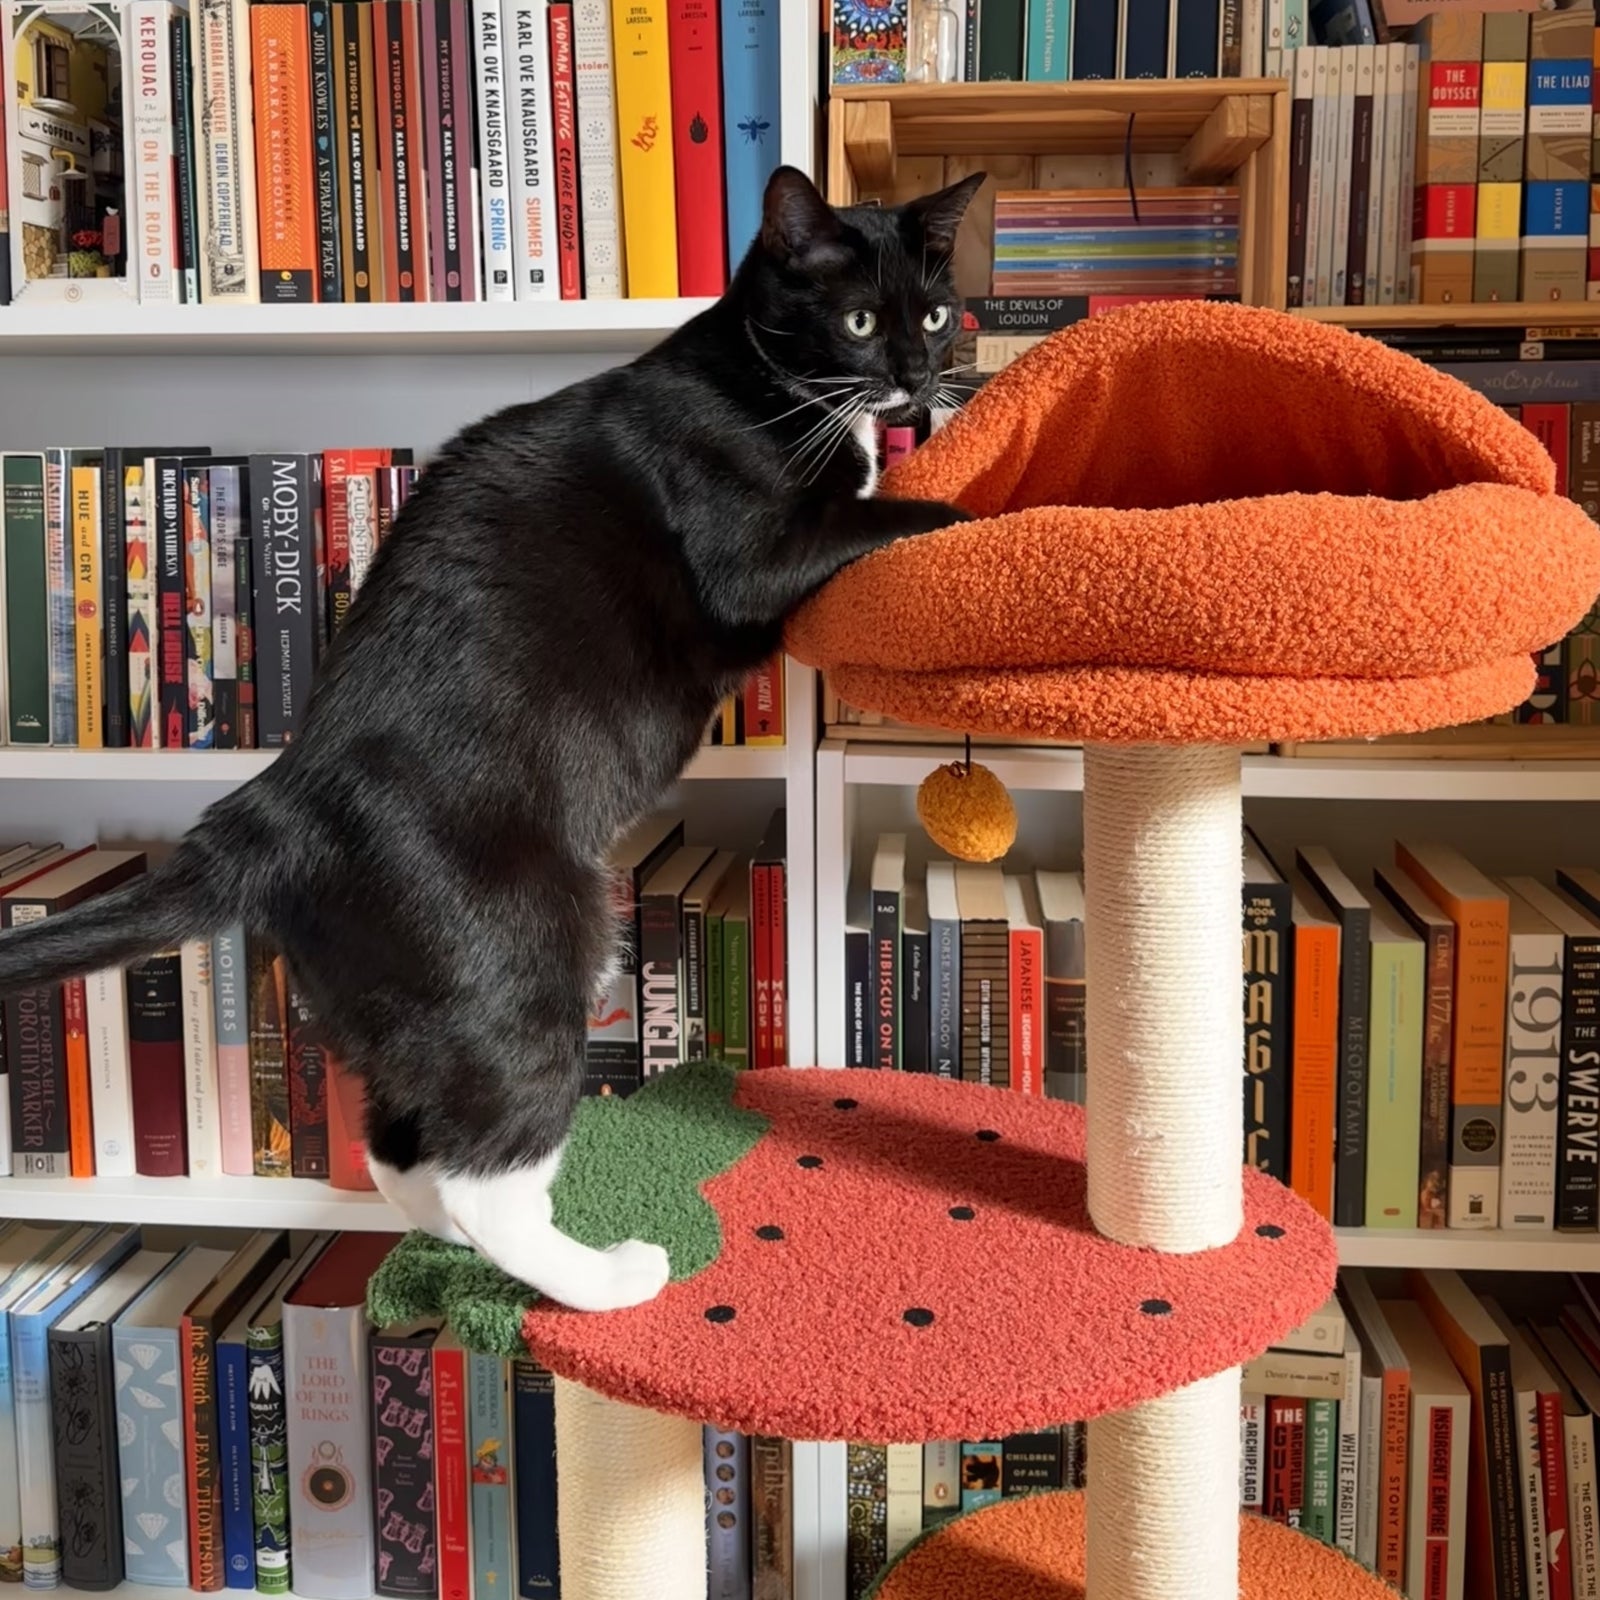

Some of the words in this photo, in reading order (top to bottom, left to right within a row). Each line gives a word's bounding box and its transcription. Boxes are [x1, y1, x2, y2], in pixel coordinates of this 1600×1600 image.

[482, 12, 496, 50] KARL
[517, 10, 531, 49] KARL
[626, 17, 652, 25] LARSSON
[139, 16, 157, 97] KEROUAC
[209, 21, 222, 67] BARBARA
[313, 31, 326, 73] JOHN
[348, 42, 356, 57] MY
[392, 40, 400, 56] MY
[552, 16, 569, 77] WOMAN,
[1043, 36, 1052, 73] Poems
[267, 38, 281, 121] BARBARA
[392, 58, 402, 111] STRUGGLE
[441, 58, 451, 111] STRUGGLE
[484, 56, 498, 83] OVE
[519, 55, 534, 82] OVE
[577, 61, 609, 71] stolen
[1446, 69, 1467, 83] THE
[1537, 75, 1557, 88] THE
[1561, 73, 1590, 88] ILIAD
[211, 70, 228, 133] KINGSOLVER
[315, 72, 328, 130] KNOWLES
[349, 60, 359, 111] STRUGGLE
[1432, 86, 1478, 101] ODYSSEY
[555, 80, 571, 140] EATING
[42, 119, 74, 142] COFFEE
[281, 85, 292, 176] POISONWOOD
[352, 132, 362, 159] KARL
[396, 132, 406, 159] KARL
[444, 131, 454, 159] KARL
[485, 90, 503, 188] KNAUSGAARD
[521, 88, 540, 187] KNAUSGAARD
[143, 140, 160, 163] ON
[215, 142, 228, 179] DEMON
[318, 157, 329, 165] A
[445, 160, 454, 180] OVE
[144, 172, 160, 202] THE
[271, 129, 286, 241] KINGSOLVER
[353, 161, 362, 180] OVE
[397, 161, 406, 180] OVE
[559, 147, 573, 198] CLAIRE
[216, 181, 233, 247] COPPERHEAD
[319, 170, 333, 234] SEPARATE
[354, 184, 365, 251] KNAUSGAARD
[398, 184, 409, 251] KNAUSGAARD
[446, 183, 457, 251] KNAUSGAARD
[1446, 189, 1456, 233] HOMER
[145, 211, 161, 257] ROAD
[490, 198, 507, 251] SPRING
[526, 197, 543, 258] SUMMER
[321, 240, 335, 279] PEACE
[984, 300, 1004, 311] THE
[1009, 299, 1045, 312] DEVILS
[1047, 299, 1063, 310] OF
[998, 314, 1049, 325] LOUDUN
[329, 457, 344, 485] SAM
[78, 490, 89, 521] HUE
[162, 468, 177, 519] RICHARD
[215, 486, 226, 503] THE
[332, 489, 345, 499] J.
[80, 526, 89, 547] and
[216, 506, 227, 545] RAZOR'S
[263, 519, 271, 539] THE
[272, 459, 302, 615] MOBY-DICK
[333, 502, 348, 551] MILLER
[164, 520, 179, 577] MATHESON
[264, 542, 272, 577] WHALE
[80, 553, 92, 584] CRY
[163, 592, 181, 627] HELL
[164, 631, 183, 685] HOUSE
[280, 629, 291, 670] HERMAN
[877, 905, 896, 914] RAO
[1246, 907, 1276, 917] BOOK
[1252, 898, 1271, 907] THE
[1254, 917, 1269, 926] OF
[941, 927, 952, 968] NORSE
[1436, 934, 1449, 970] CLINE
[218, 936, 237, 1032] MOTHERS
[854, 982, 862, 995] THE
[880, 939, 893, 1016] HIBISCUS
[981, 979, 991, 1002] EDITH
[1020, 940, 1033, 1010] JAPANESE
[642, 961, 680, 1077] JUNGLE
[756, 979, 768, 1027] MAUS
[771, 979, 784, 1027] MAUS
[940, 972, 951, 1049] MYTHOLOGY
[1430, 985, 1452, 1024] 1177
[191, 1018, 203, 1043] great
[774, 1034, 783, 1049] II
[855, 1019, 863, 1030] OF
[880, 1026, 893, 1050] ON
[981, 1004, 991, 1042] HAMILTON
[1021, 1012, 1032, 1057] LEGENDS
[1508, 951, 1564, 1113] 1913
[1574, 1026, 1597, 1038] THE
[760, 1035, 766, 1049] I
[41, 1015, 56, 1107] PORTABLE
[1344, 1015, 1363, 1157] MESOPOTAMIA
[22, 1079, 43, 1147] PARKER
[1566, 1048, 1600, 1164] SWERVE
[191, 1325, 207, 1348] the
[301, 1373, 346, 1387] LORD
[304, 1356, 338, 1370] THE
[295, 1391, 314, 1403] OF
[300, 1408, 350, 1422] RINGS
[1315, 1401, 1329, 1422] I'M
[1386, 1393, 1396, 1434] GATES,
[1397, 1384, 1406, 1424] HENRY
[1275, 1408, 1303, 1424] THE
[195, 1432, 210, 1479] JEAN
[1006, 1452, 1056, 1462] CHILDREN
[1244, 1421, 1259, 1502] ARCHIPELAGO
[1313, 1428, 1329, 1465] STILL
[1341, 1433, 1357, 1474] WHITE
[1432, 1408, 1450, 1480] INSURGENT
[1013, 1469, 1026, 1477] OF
[1027, 1469, 1049, 1477] ASH
[1290, 1424, 1304, 1505] ARCHIPELAGO
[1313, 1470, 1328, 1507] HERE
[1388, 1476, 1400, 1527] STONY
[1528, 1474, 1537, 1493] THE
[1581, 1481, 1591, 1502] THE
[1340, 1479, 1355, 1541] FRAGILITY
[1430, 1486, 1449, 1534] EMPIRE
[1530, 1496, 1540, 1533] RIGHTS
[197, 1486, 215, 1587] THOMPSON
[1387, 1534, 1399, 1561] THE
[1532, 1536, 1541, 1549] OF
[1582, 1505, 1594, 1560] OBSTACLE
[1534, 1552, 1543, 1574] MAN
[1586, 1563, 1594, 1573] IS
[1586, 1576, 1596, 1596] THE
